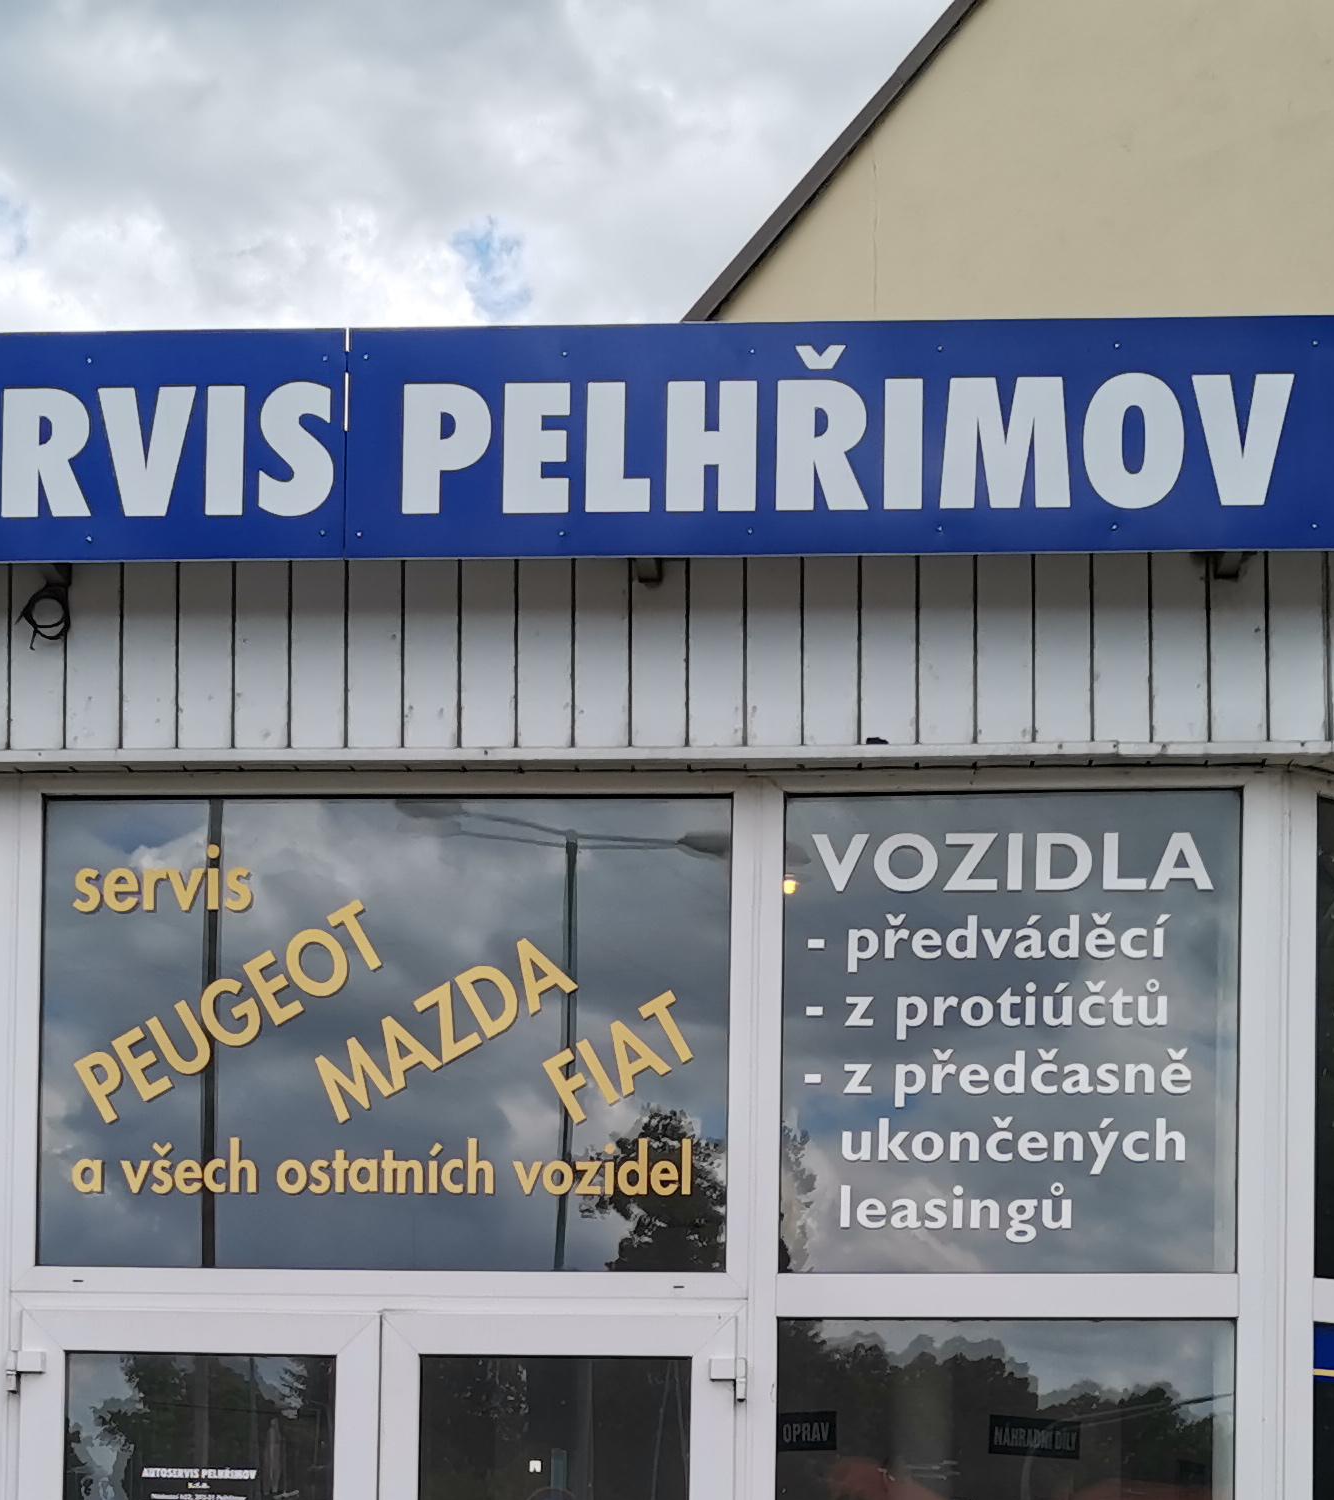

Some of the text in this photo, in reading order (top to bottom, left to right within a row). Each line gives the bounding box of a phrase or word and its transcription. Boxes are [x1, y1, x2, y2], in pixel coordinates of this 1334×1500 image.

[400, 345, 1295, 515] PELHŘIMOV
[72, 844, 255, 913] servis
[812, 832, 1215, 893] VOZIDLA
[847, 913, 1172, 973] předváděcí
[74, 899, 384, 1124] PEUGEOT
[315, 938, 578, 1124] MAZDA
[844, 995, 874, 1027] z
[896, 979, 1168, 1040] protiúčtů
[542, 990, 694, 1124] FIAT
[843, 1062, 872, 1094] z
[894, 1048, 1192, 1108] předčasně
[72, 1136, 693, 1196] a všech ostatních vozidel
[841, 1116, 1187, 1175] ukončených
[839, 1182, 1073, 1244] leasingů
[141, 1468, 200, 1479] AUTOSERVIS
